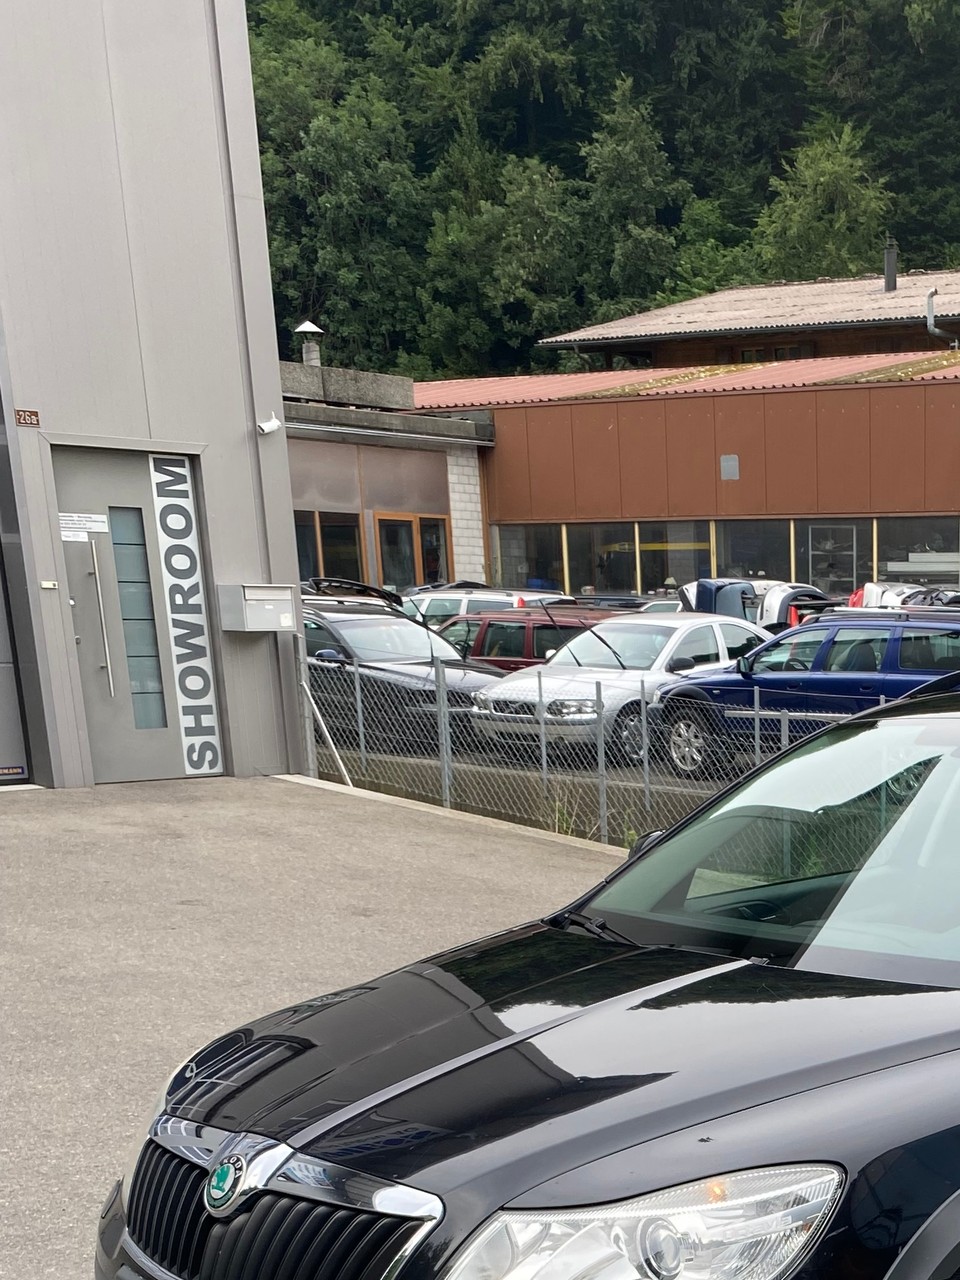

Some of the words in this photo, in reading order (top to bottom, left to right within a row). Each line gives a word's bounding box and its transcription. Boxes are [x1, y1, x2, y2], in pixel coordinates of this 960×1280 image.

[19, 411, 37, 424] 26a
[153, 456, 219, 771] SHOWROOM
[221, 1155, 243, 1179] KODA
